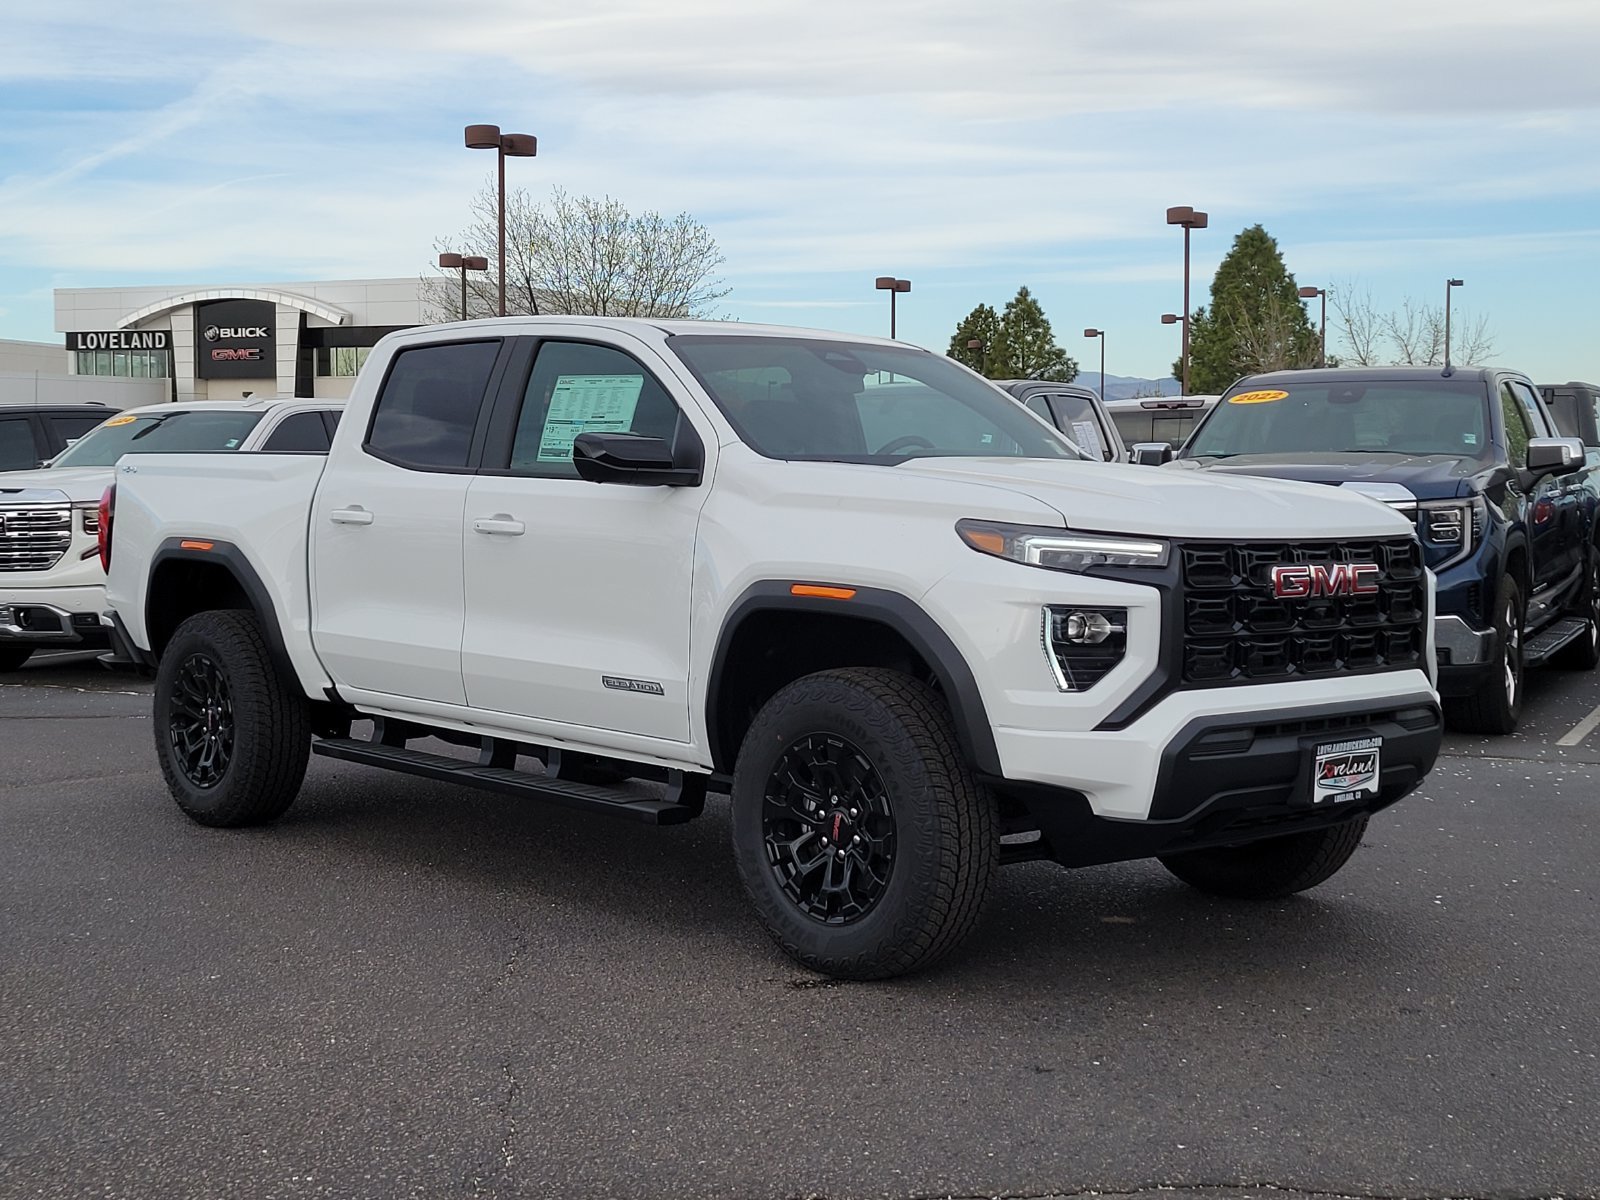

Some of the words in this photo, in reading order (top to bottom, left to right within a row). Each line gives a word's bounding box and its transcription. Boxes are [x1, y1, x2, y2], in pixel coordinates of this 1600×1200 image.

[219, 326, 268, 338] BUICK
[77, 332, 166, 349] LOVELAND
[211, 348, 260, 361] GMC
[1234, 392, 1284, 402] 2022
[1271, 563, 1379, 599] GMC
[605, 679, 660, 692] ELEVATION
